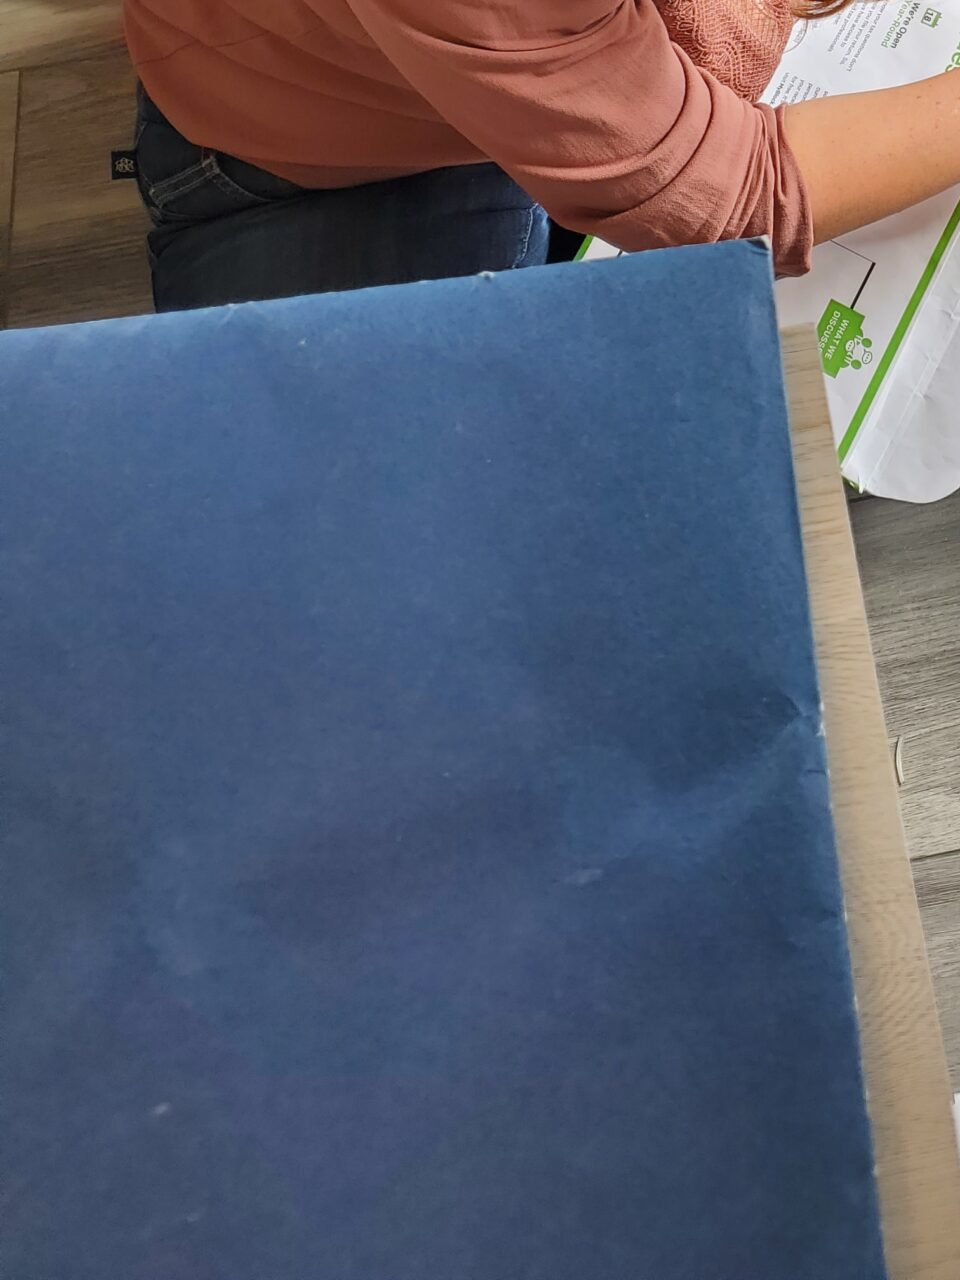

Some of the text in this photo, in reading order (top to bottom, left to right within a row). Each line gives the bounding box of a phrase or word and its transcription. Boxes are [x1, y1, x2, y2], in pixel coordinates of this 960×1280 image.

[881, 0, 913, 48] Year-Round
[889, 1, 920, 49] We're Open
[825, 319, 850, 360] WHAT WE
